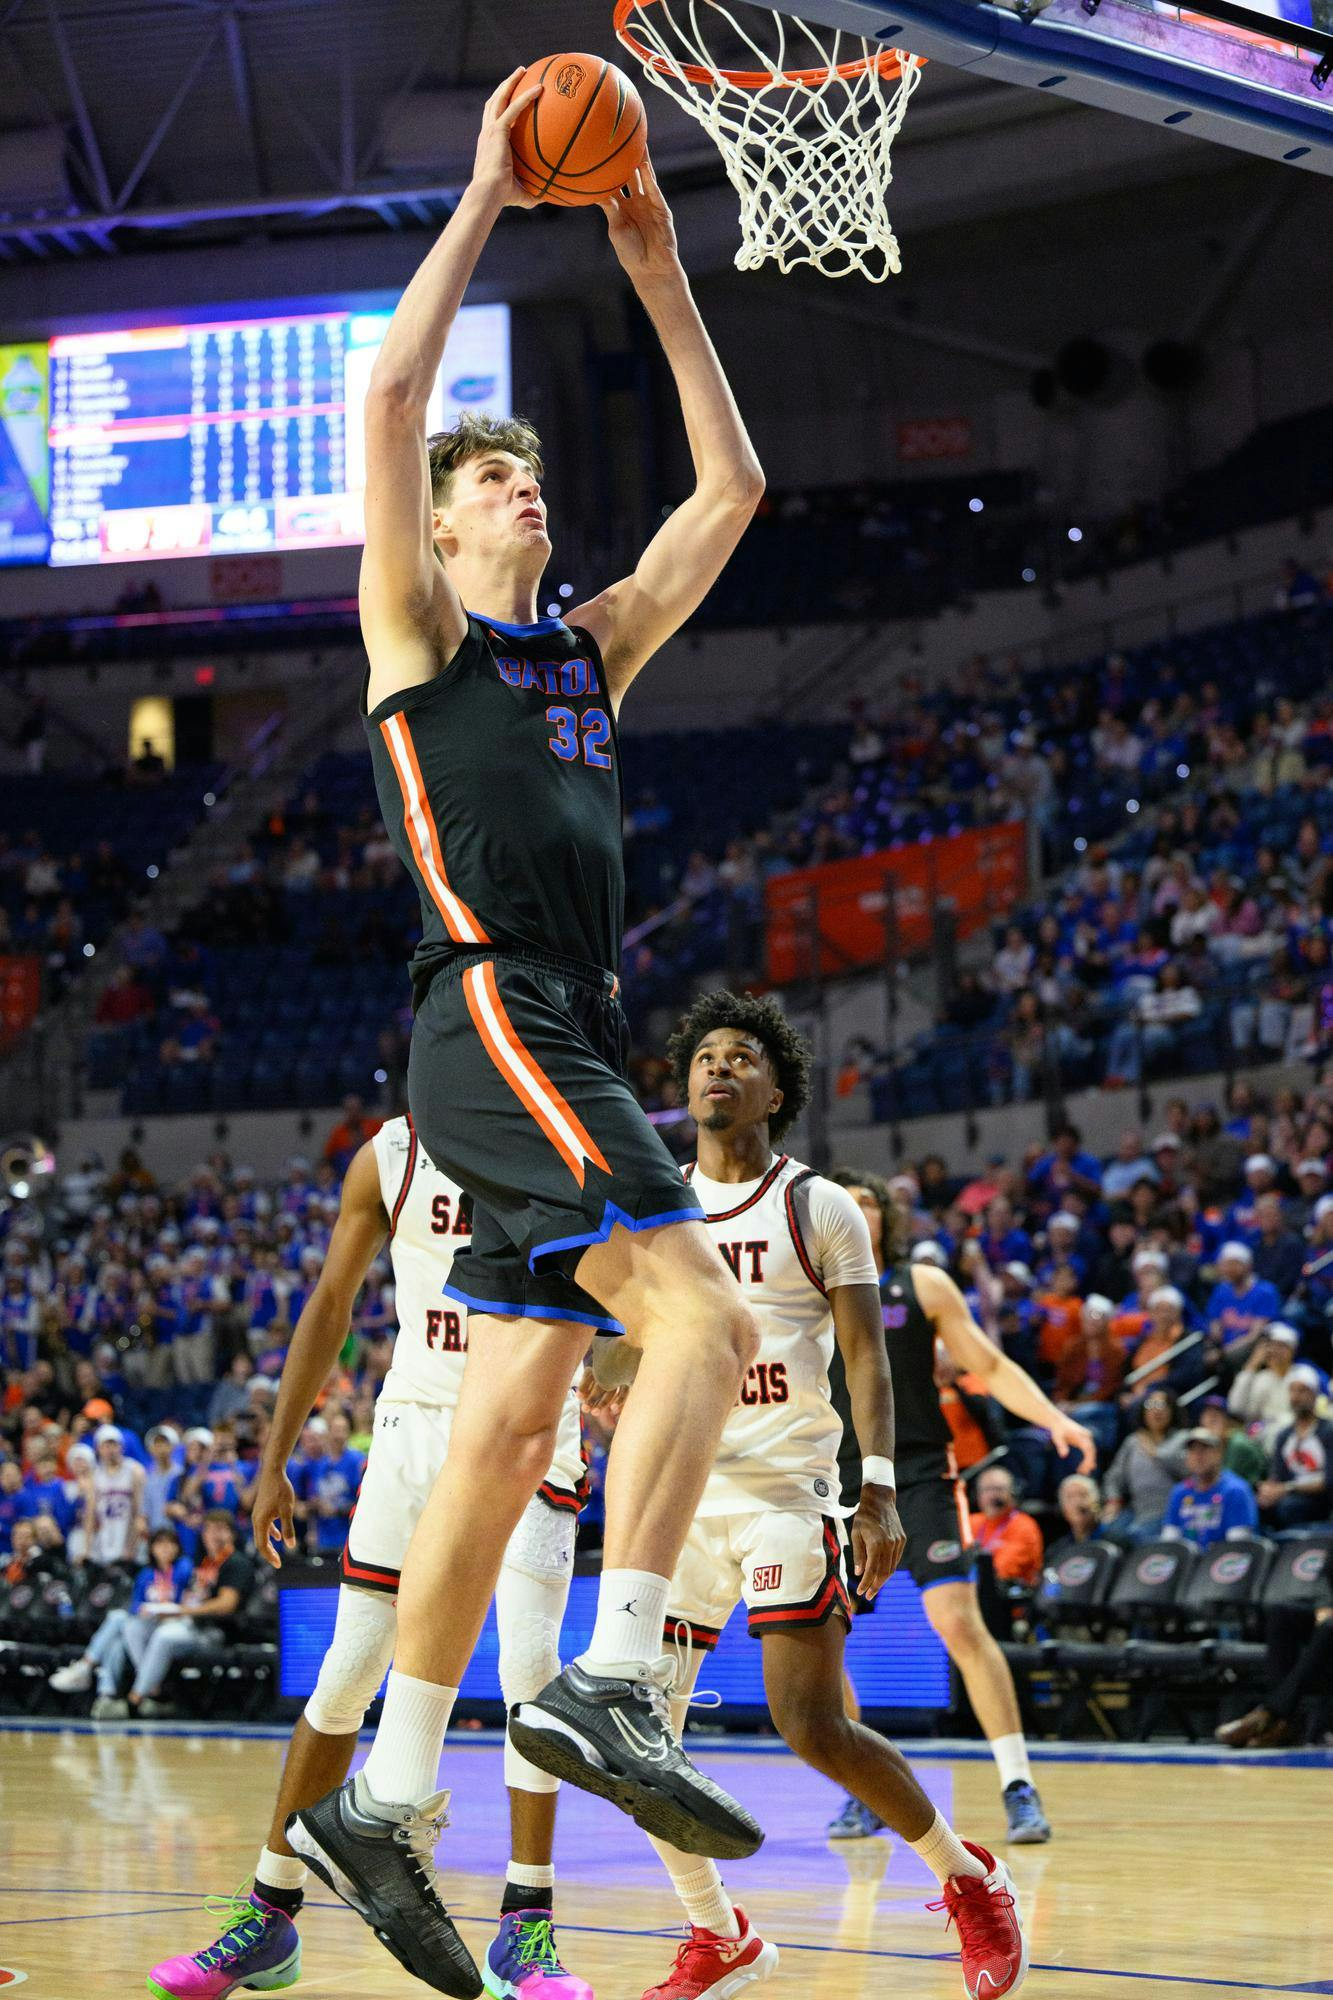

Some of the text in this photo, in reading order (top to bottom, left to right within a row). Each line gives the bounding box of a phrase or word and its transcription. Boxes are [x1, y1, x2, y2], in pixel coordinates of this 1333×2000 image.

[545, 705, 612, 770] 32
[426, 1310, 468, 1352] FR
[733, 1362, 789, 1406] CIS
[752, 1563, 783, 1592] SFU
